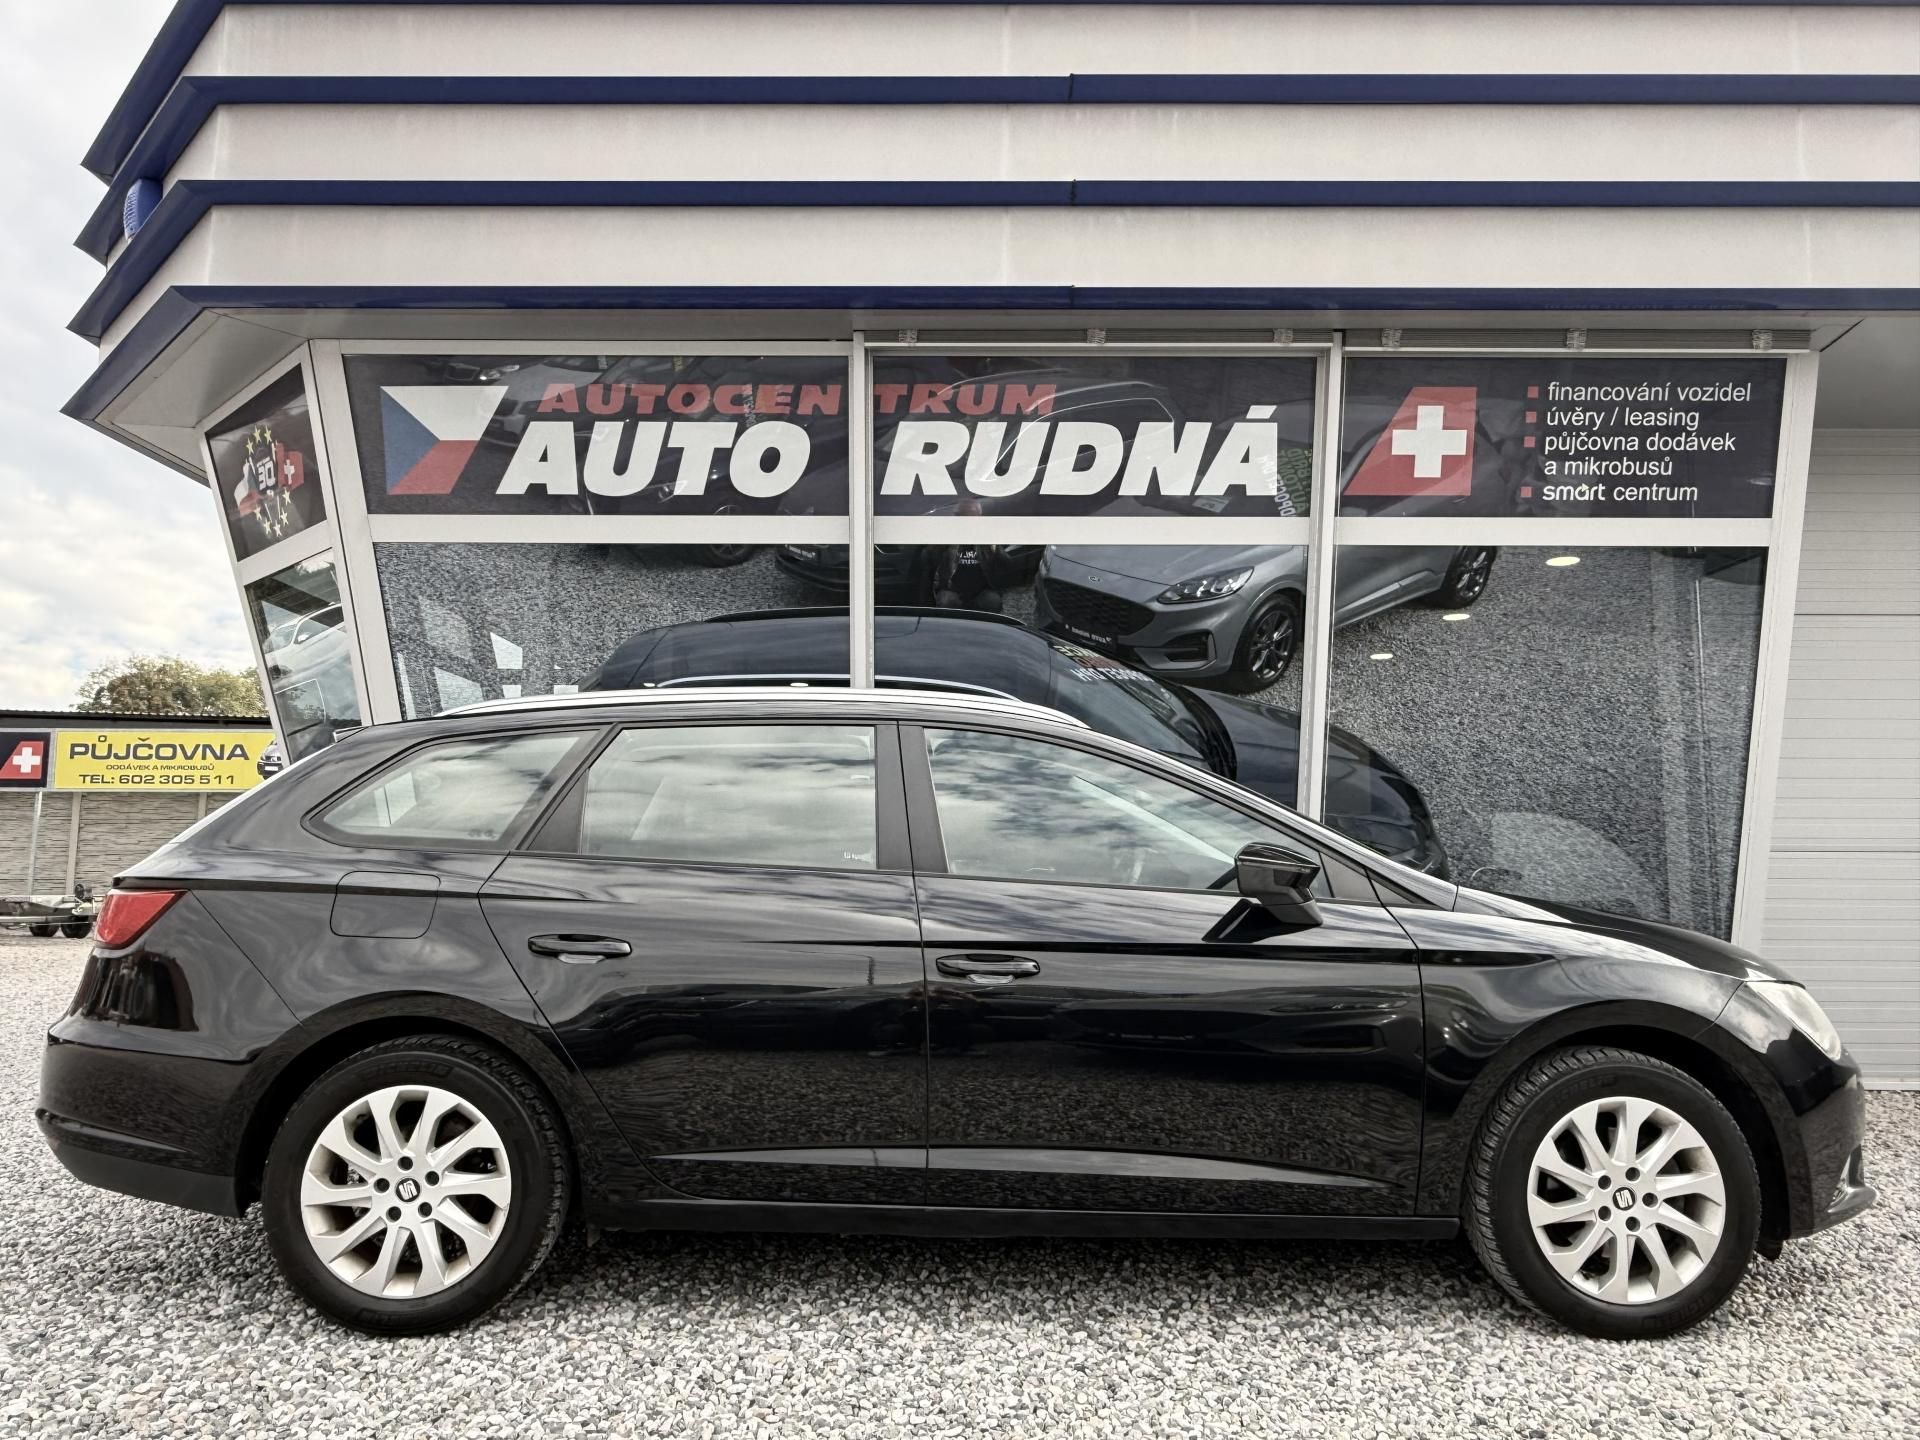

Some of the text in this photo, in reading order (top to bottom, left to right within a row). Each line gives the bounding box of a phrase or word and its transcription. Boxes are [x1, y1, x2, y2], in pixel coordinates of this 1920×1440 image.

[1548, 382, 1752, 402] financování vozidel
[1547, 406, 1606, 431] úvěry
[1624, 406, 1700, 431] leasing
[496, 405, 1278, 498] AUTO RUDNÁ
[1544, 431, 1737, 456] půjčovna dodávek
[1544, 456, 1673, 476] a mikrobusů
[1542, 482, 1698, 501] smart centrum
[69, 735, 250, 761] PŮJČOVNA
[105, 763, 151, 771] DODÁVEK
[79, 774, 235, 785] TEL: 602 305 511
